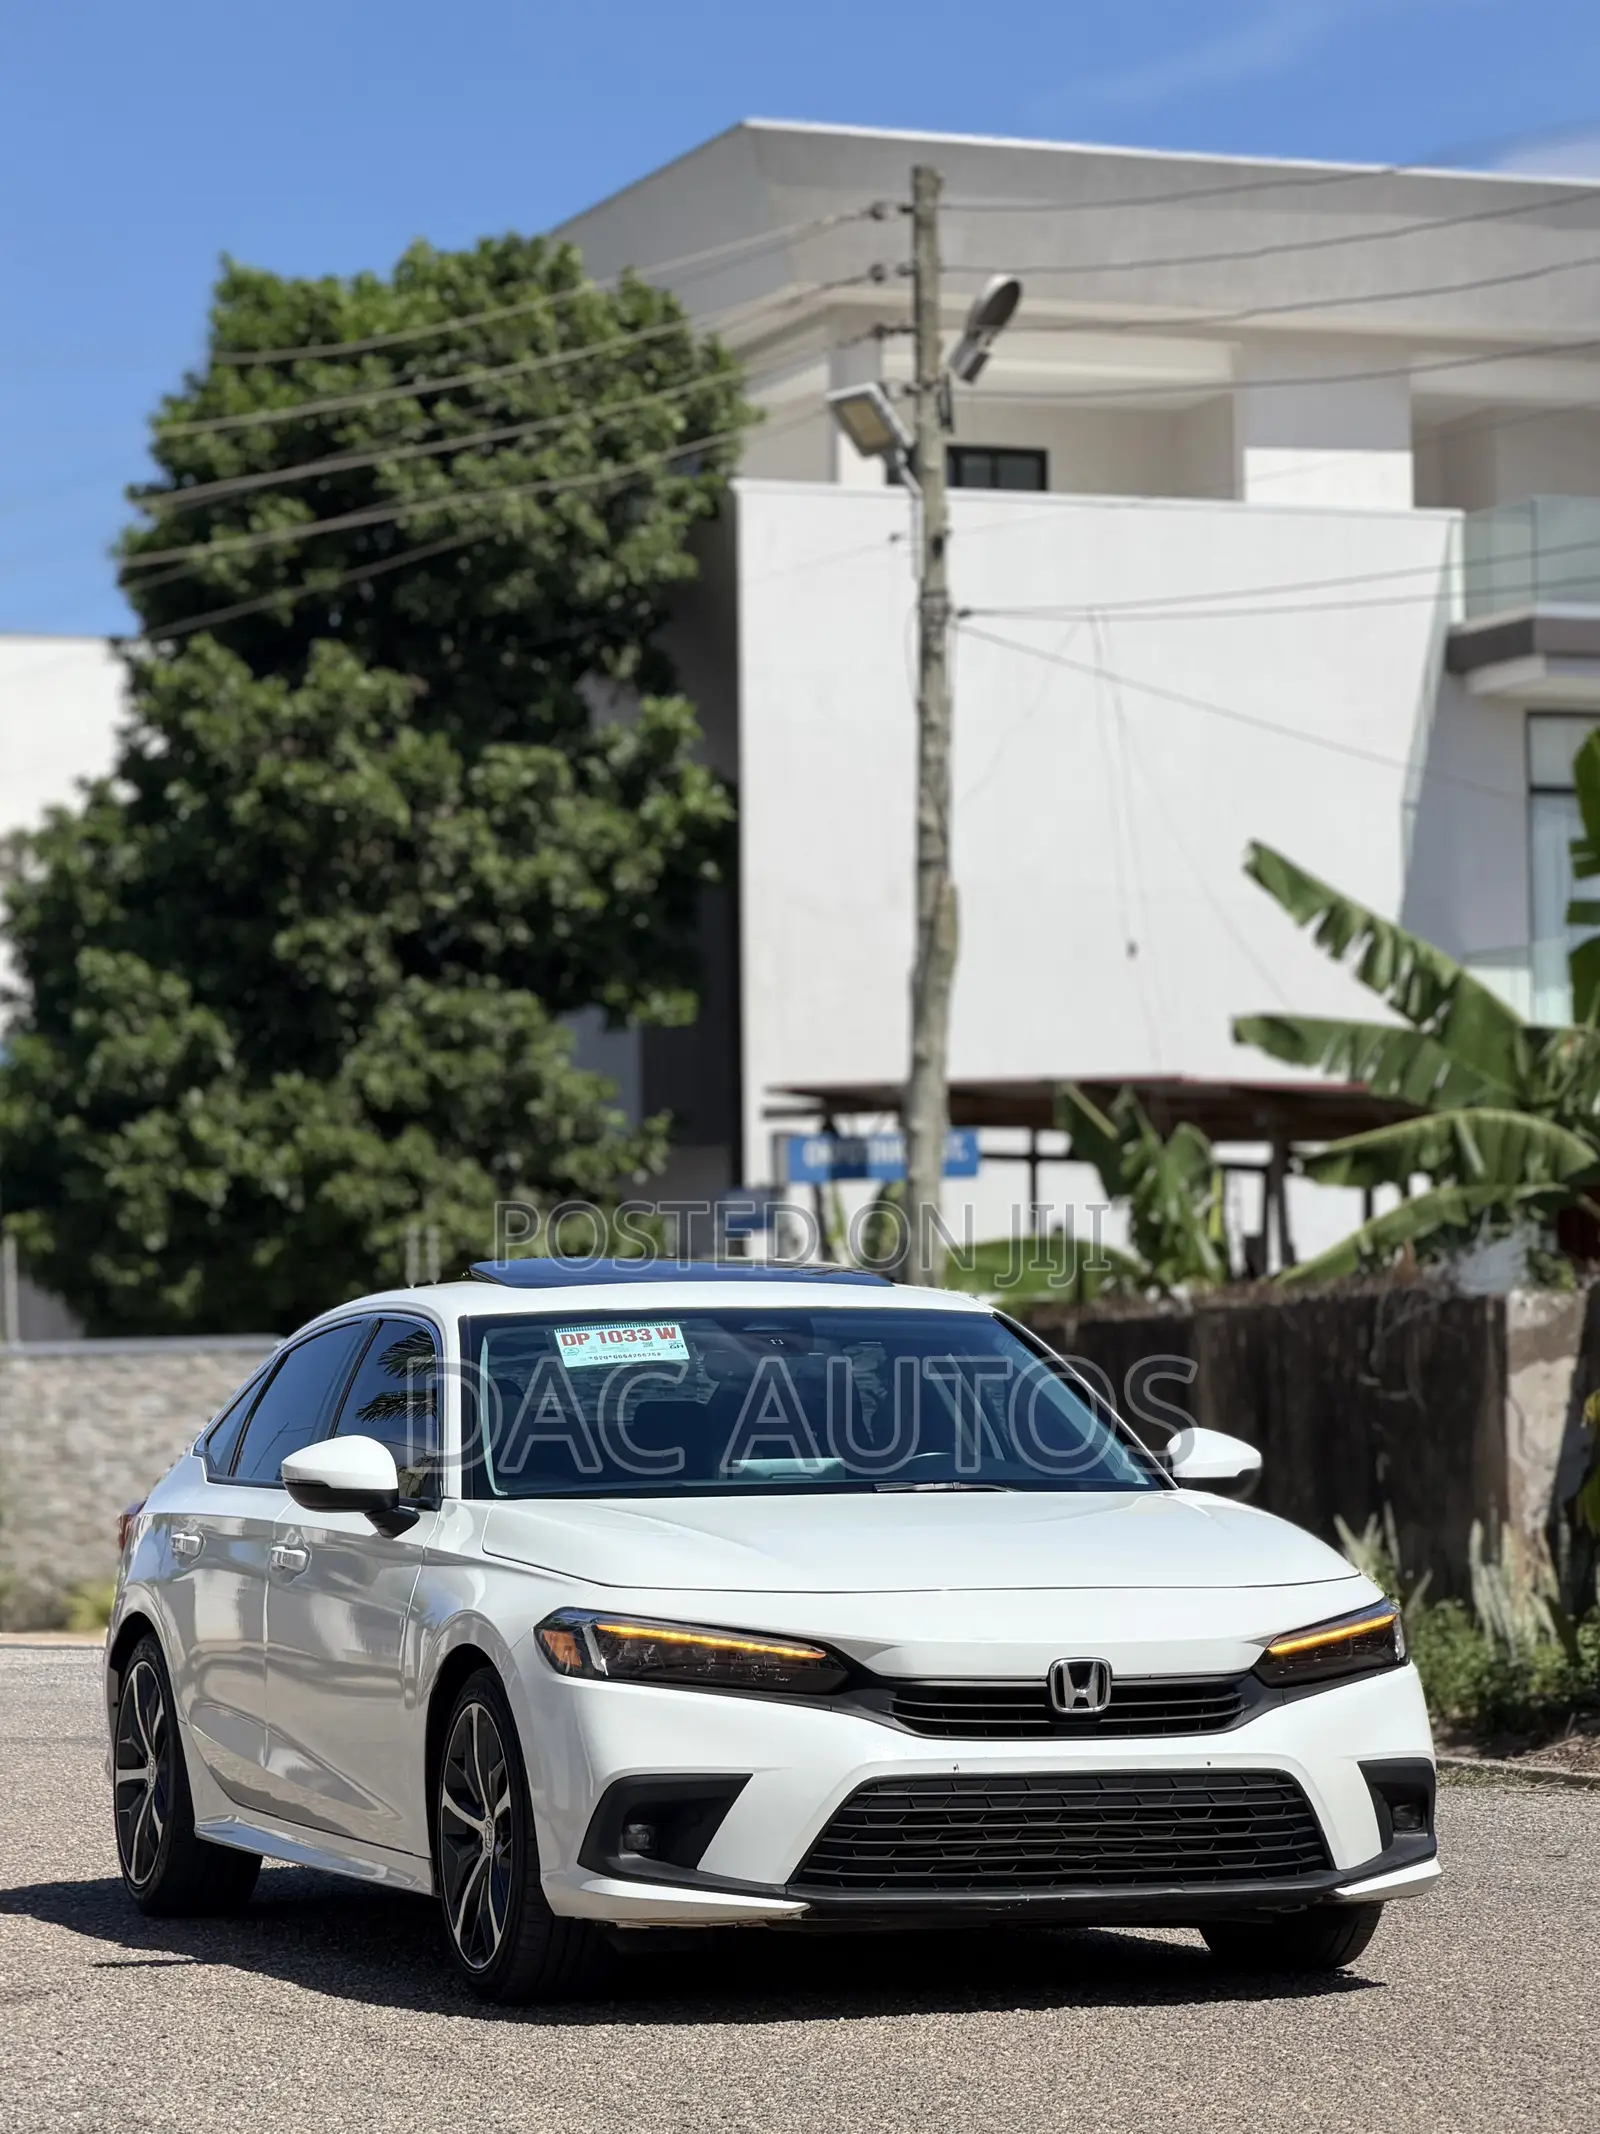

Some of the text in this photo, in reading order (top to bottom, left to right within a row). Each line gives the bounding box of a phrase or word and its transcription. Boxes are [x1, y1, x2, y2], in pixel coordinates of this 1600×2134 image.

[561, 1327, 677, 1346] DP 1033 W
